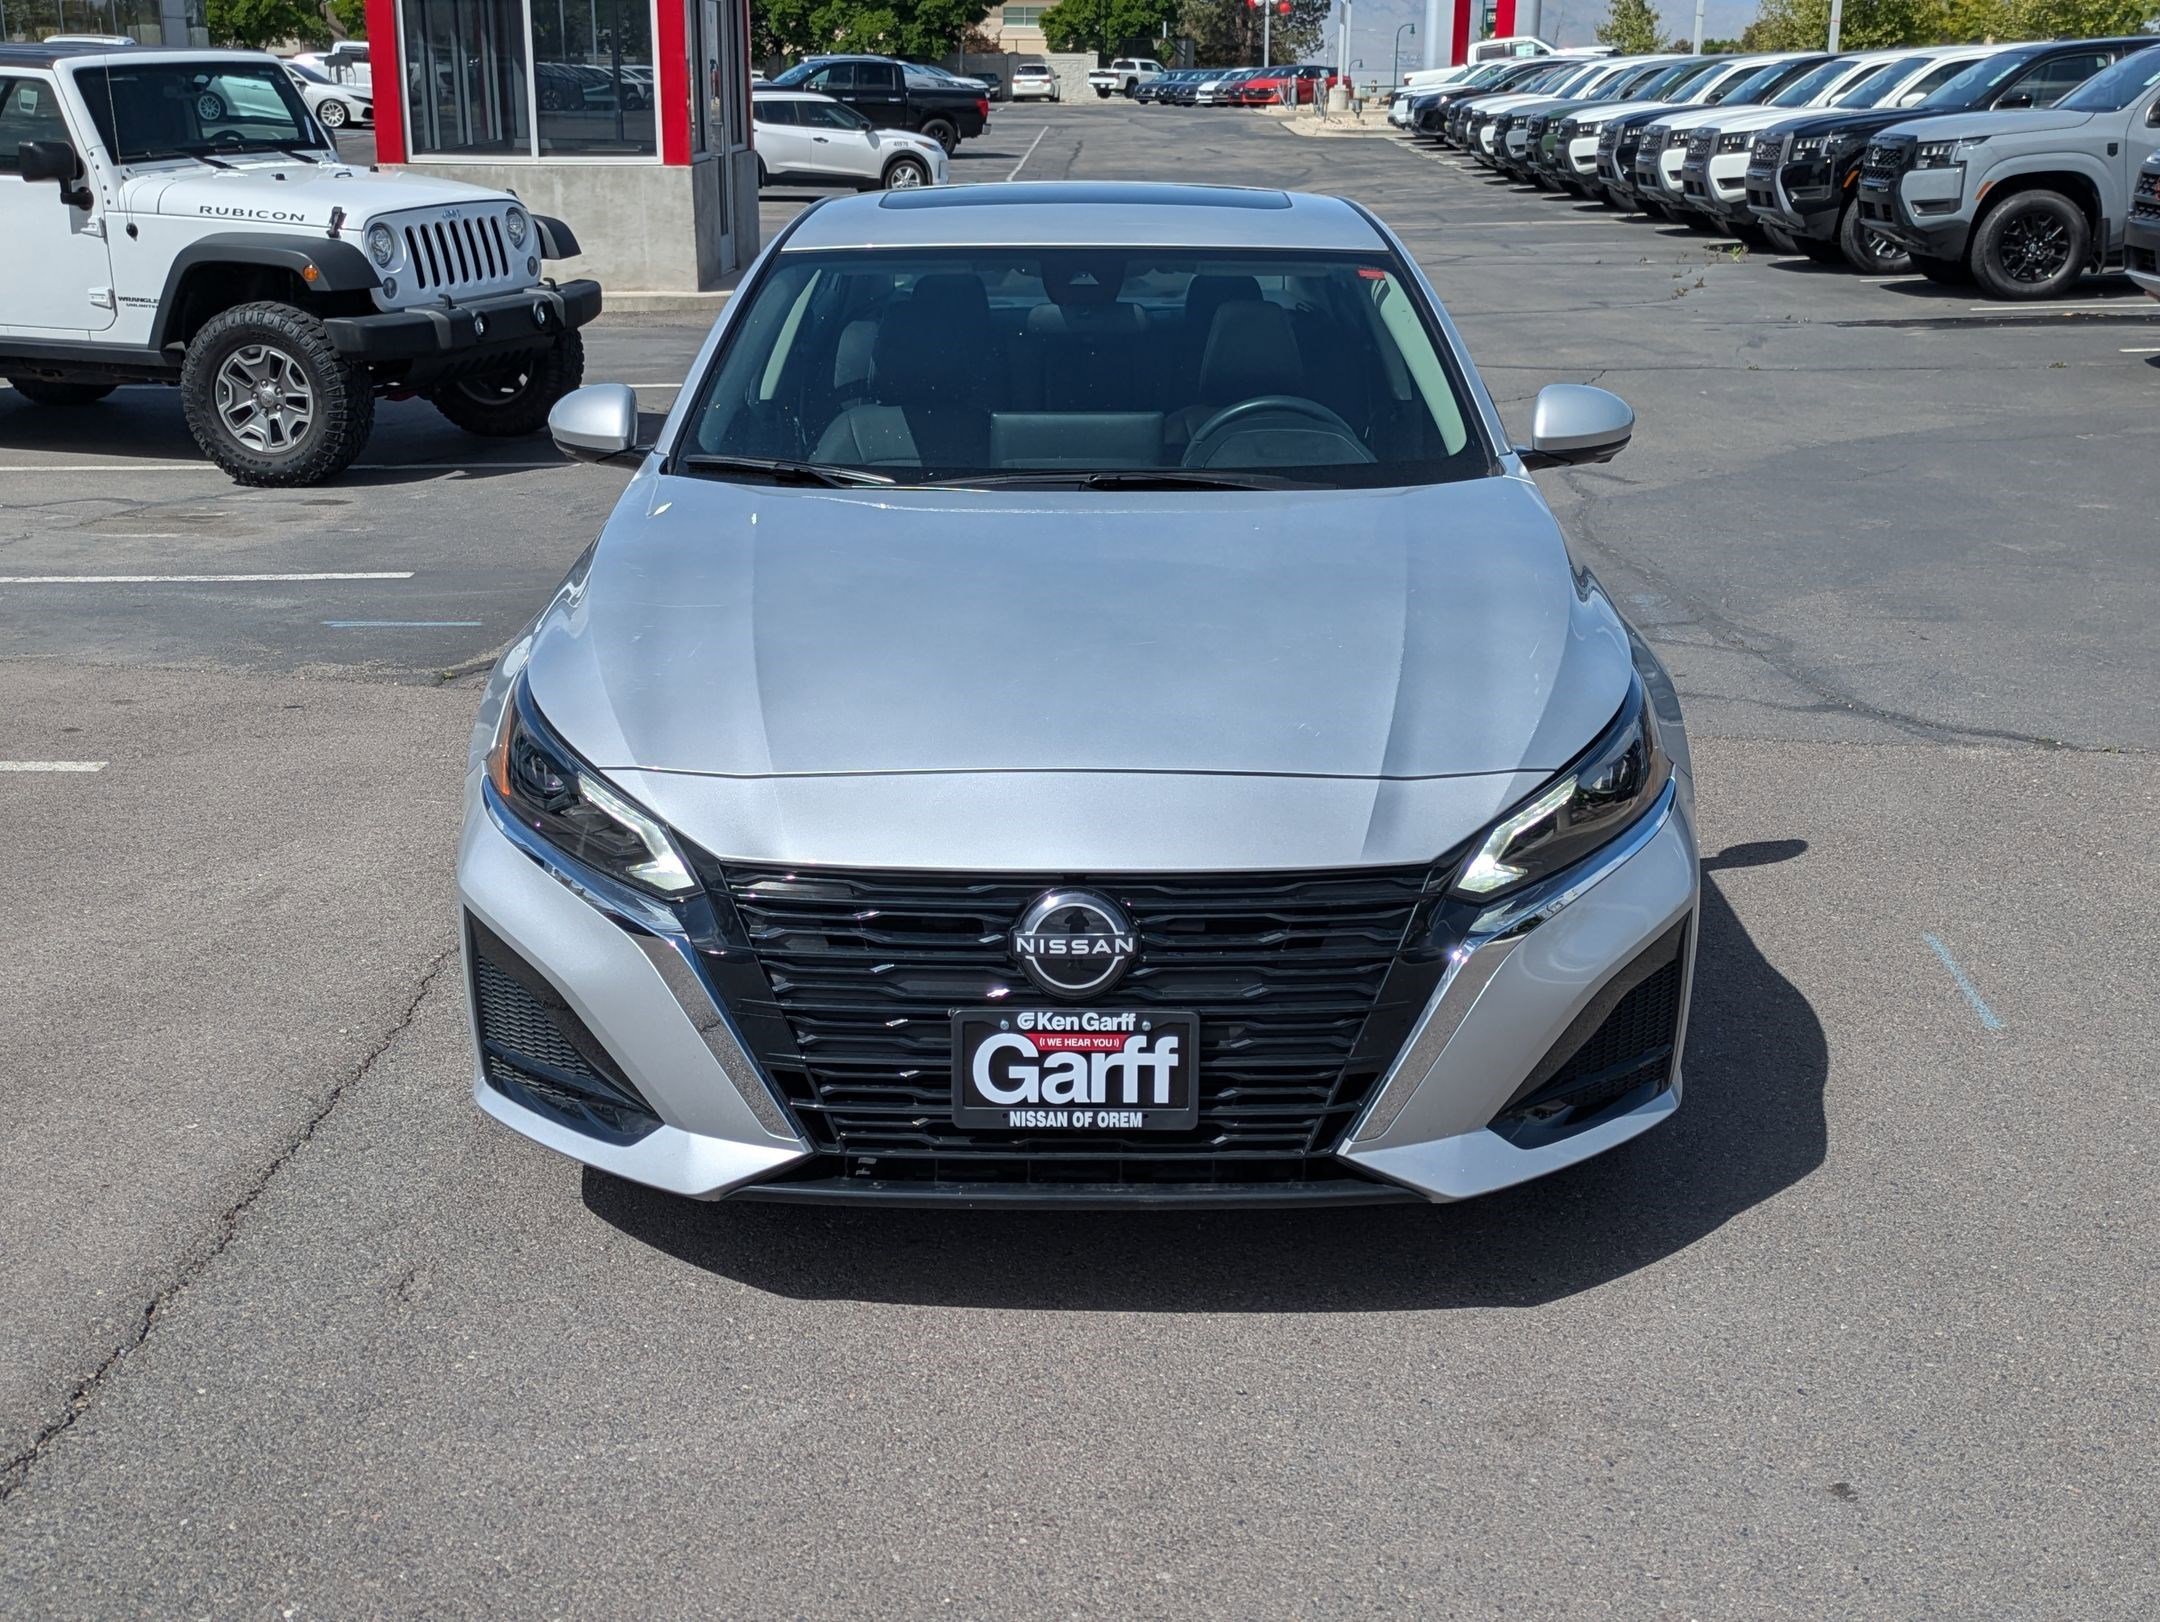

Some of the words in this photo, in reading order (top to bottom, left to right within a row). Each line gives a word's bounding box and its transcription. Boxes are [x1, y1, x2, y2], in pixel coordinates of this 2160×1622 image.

[199, 205, 305, 222] RUBICON
[1016, 937, 1133, 955] NISSAN
[1037, 1012, 1079, 1031] Ken
[1081, 1012, 1136, 1031] Garff
[1047, 1038, 1062, 1047] WE
[1064, 1038, 1091, 1047] HEAR
[1092, 1038, 1113, 1048] YOU
[972, 1033, 1179, 1104] Garff
[1009, 1111, 1068, 1128] NISSAN
[1072, 1111, 1093, 1128] OF
[1097, 1111, 1143, 1128] OREM
